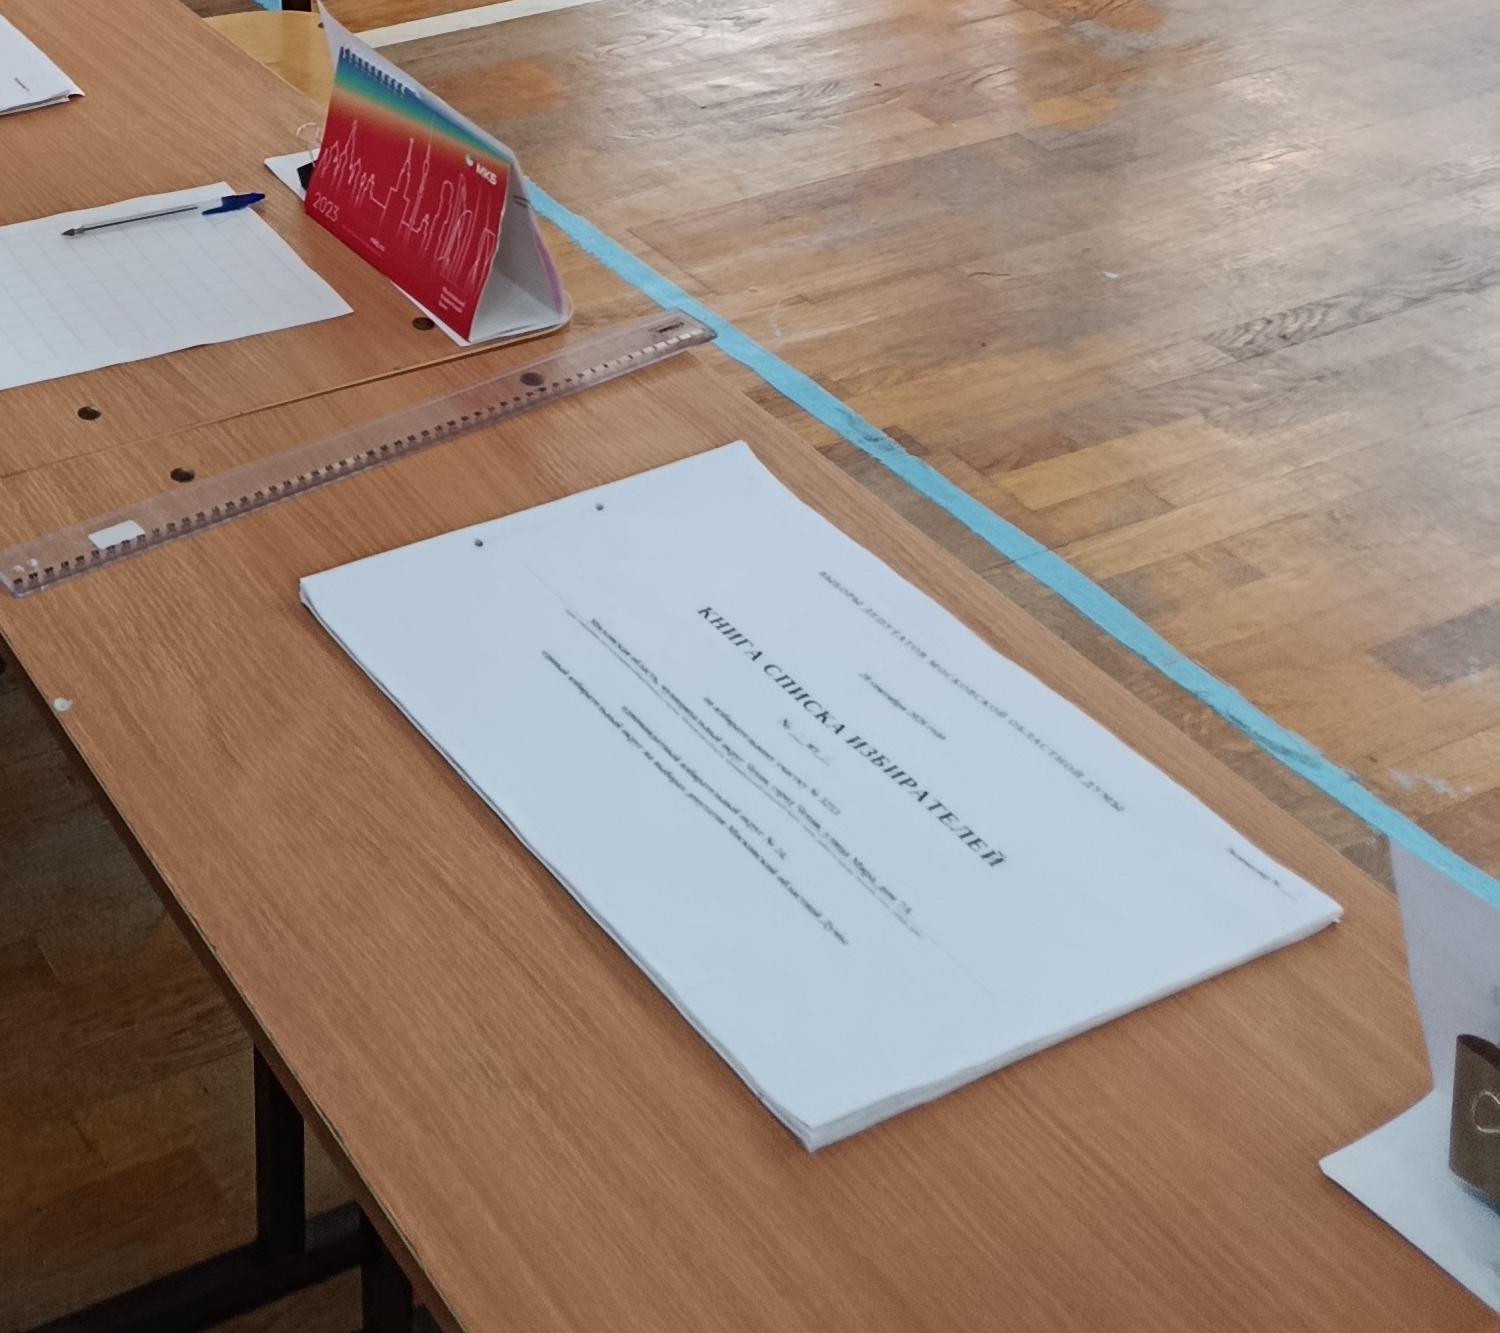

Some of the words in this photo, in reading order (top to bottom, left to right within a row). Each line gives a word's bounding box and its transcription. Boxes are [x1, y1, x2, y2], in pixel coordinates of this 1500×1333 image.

[312, 191, 338, 223] 2023
[697, 607, 763, 662] КНИГА
[763, 664, 846, 735] СПИСКА
[845, 735, 1007, 867] ИЗБИРАТЕЛЕЙ
